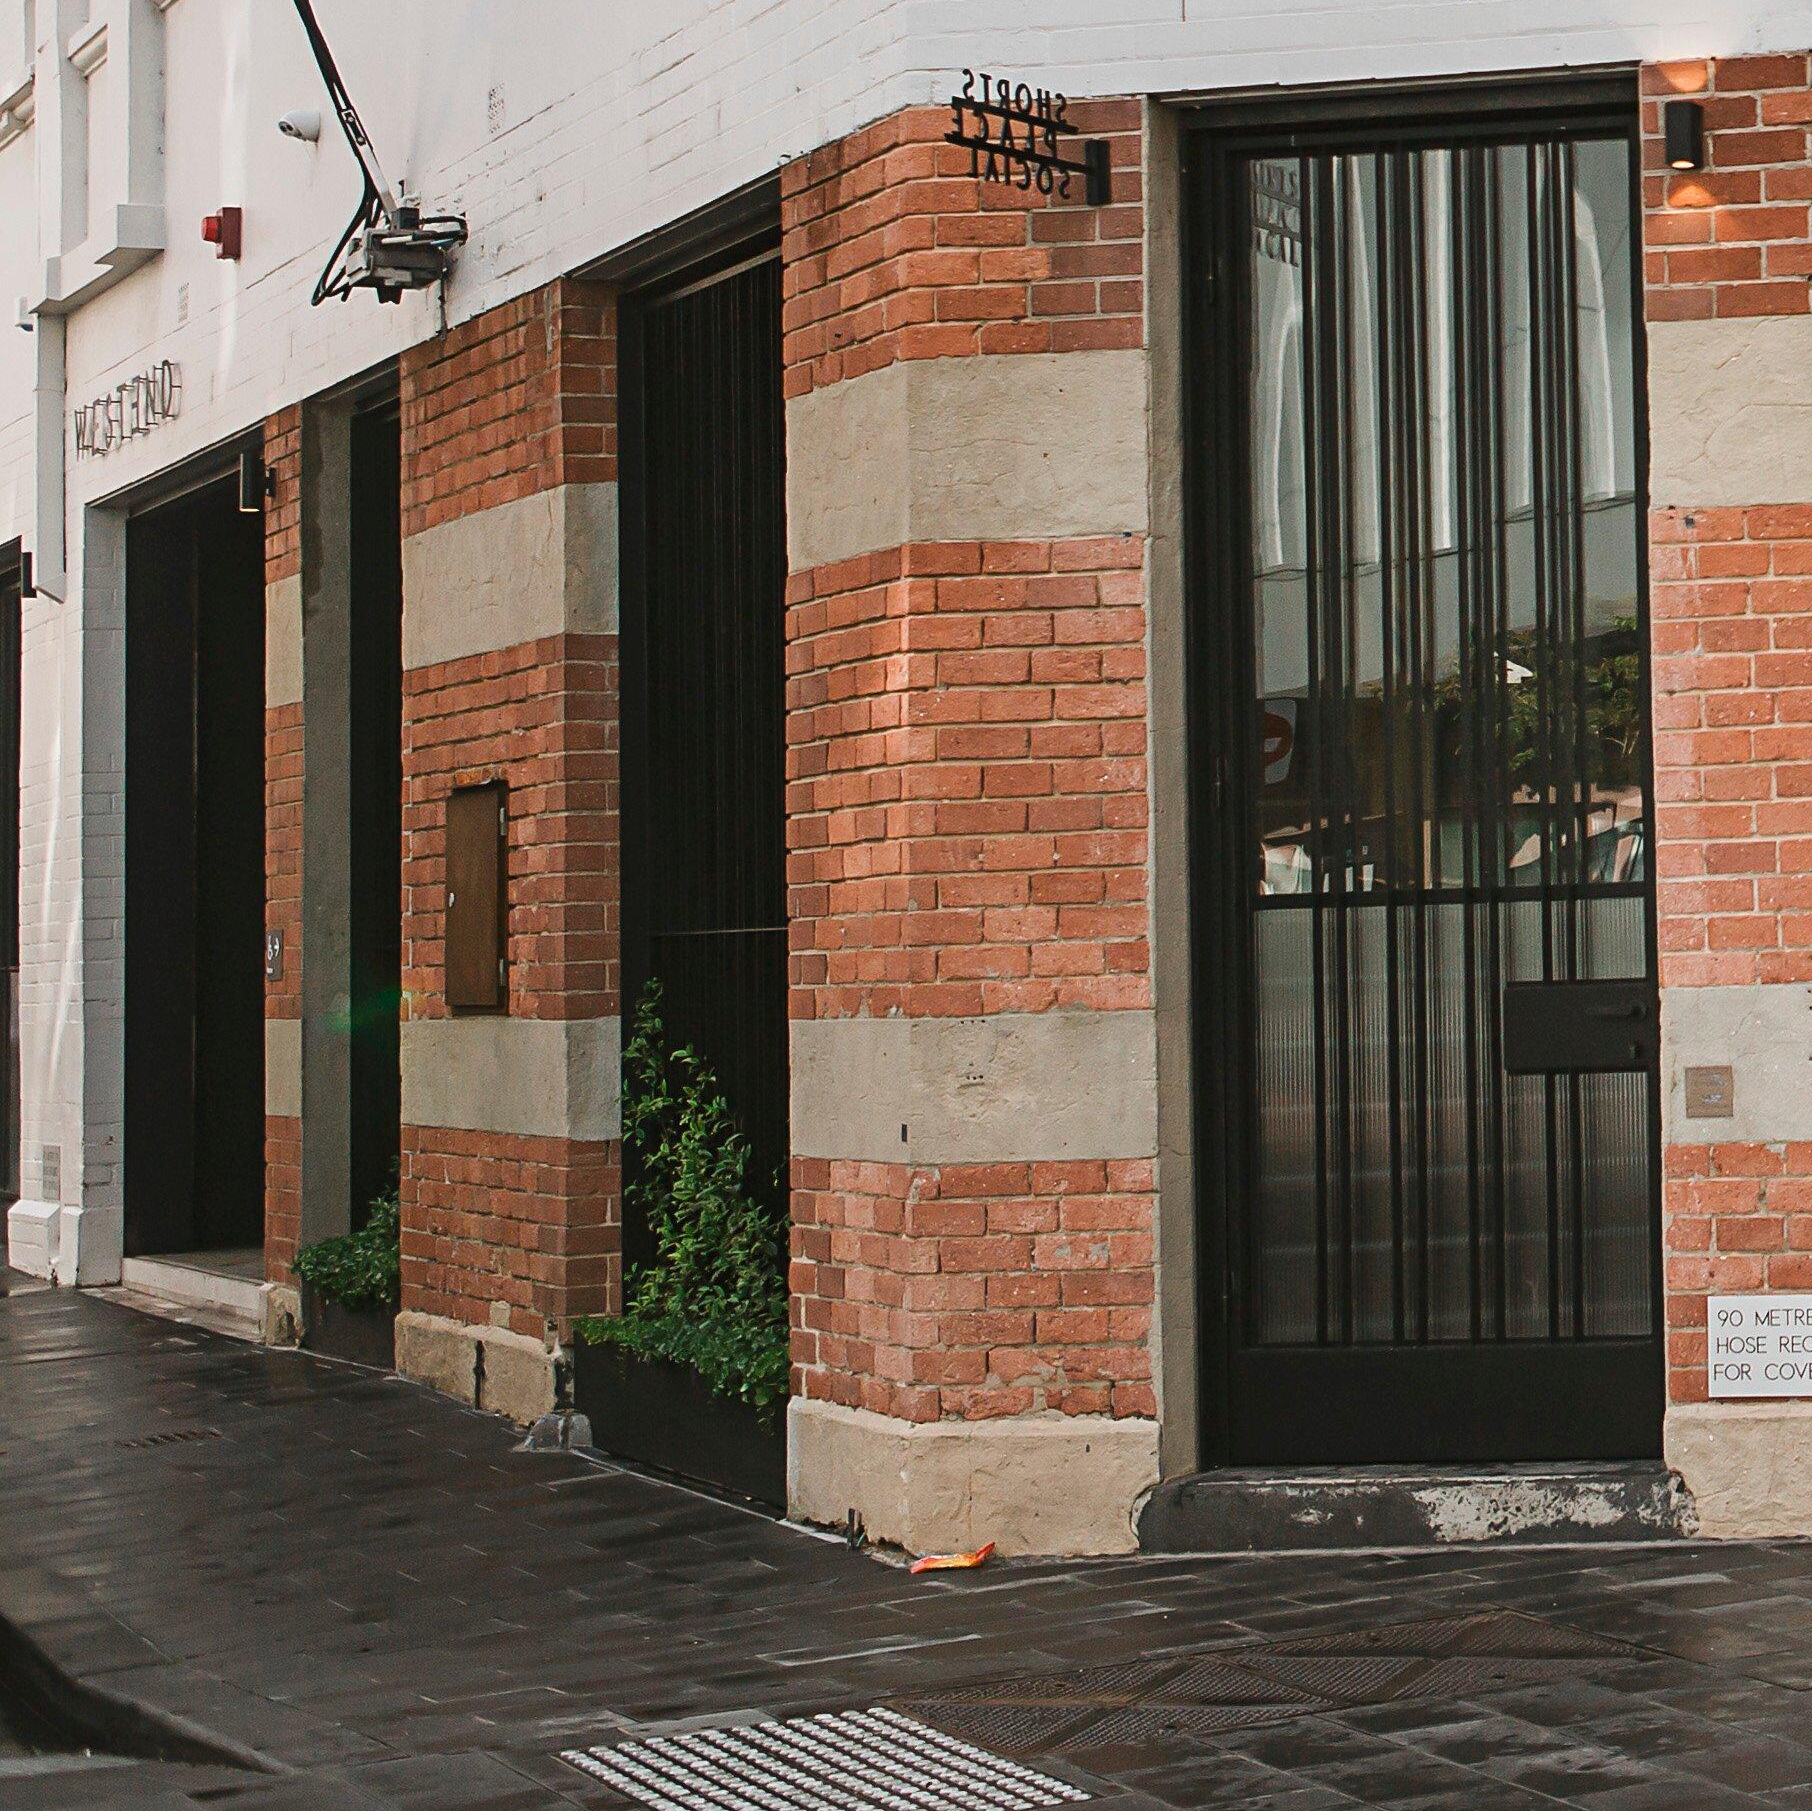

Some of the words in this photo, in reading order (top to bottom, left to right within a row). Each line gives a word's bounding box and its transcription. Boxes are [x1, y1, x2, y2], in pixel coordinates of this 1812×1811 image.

[1717, 1309, 1743, 1327] 90
[1716, 1336, 1767, 1354] HOSE
[1713, 1363, 1752, 1381] FOR
